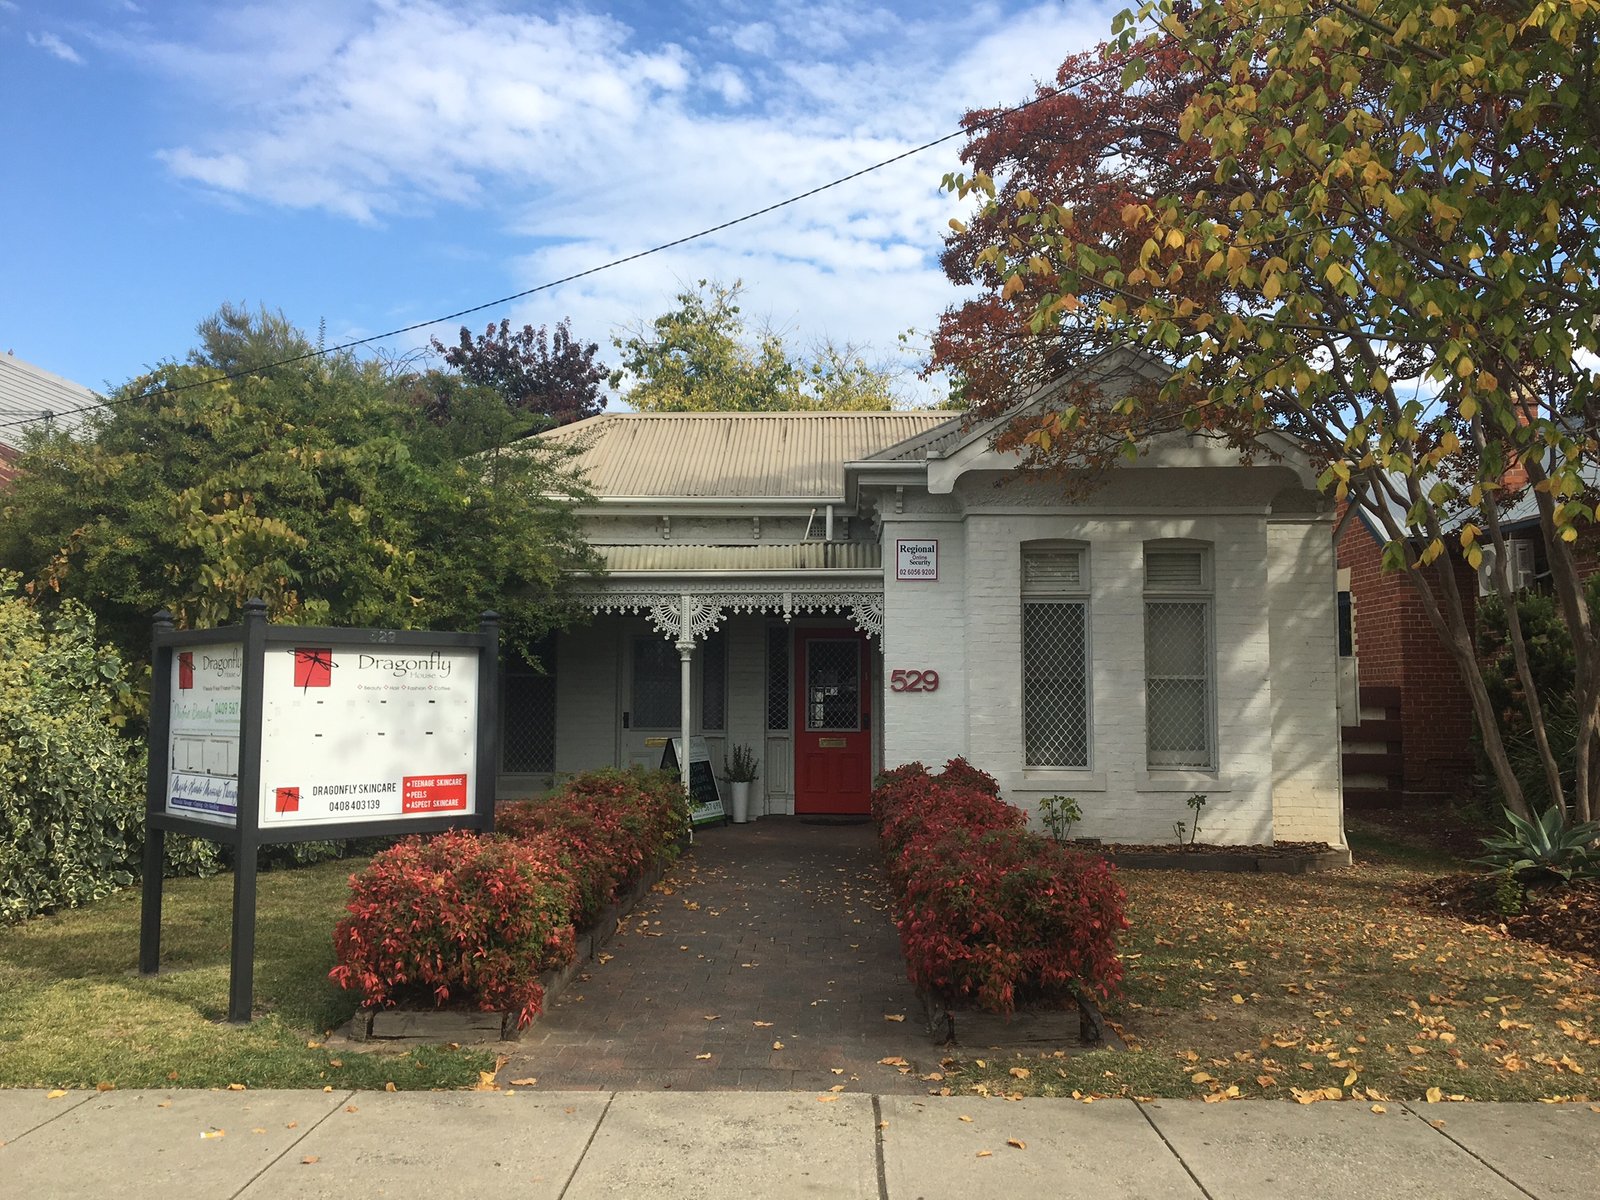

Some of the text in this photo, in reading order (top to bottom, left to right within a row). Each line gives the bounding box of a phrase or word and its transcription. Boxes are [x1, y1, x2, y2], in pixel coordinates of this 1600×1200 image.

[900, 544, 935, 554] Regional
[203, 648, 242, 677] Dragonfly
[358, 650, 451, 679] Dragonfly
[410, 671, 437, 679] House
[890, 669, 939, 692] 529
[411, 778, 463, 788] TEENAGE SKINCARE
[312, 782, 397, 796] DRAGONFLY SKINCARE
[411, 790, 427, 799] PEELS
[411, 798, 459, 808] ASPECT SKINCARE
